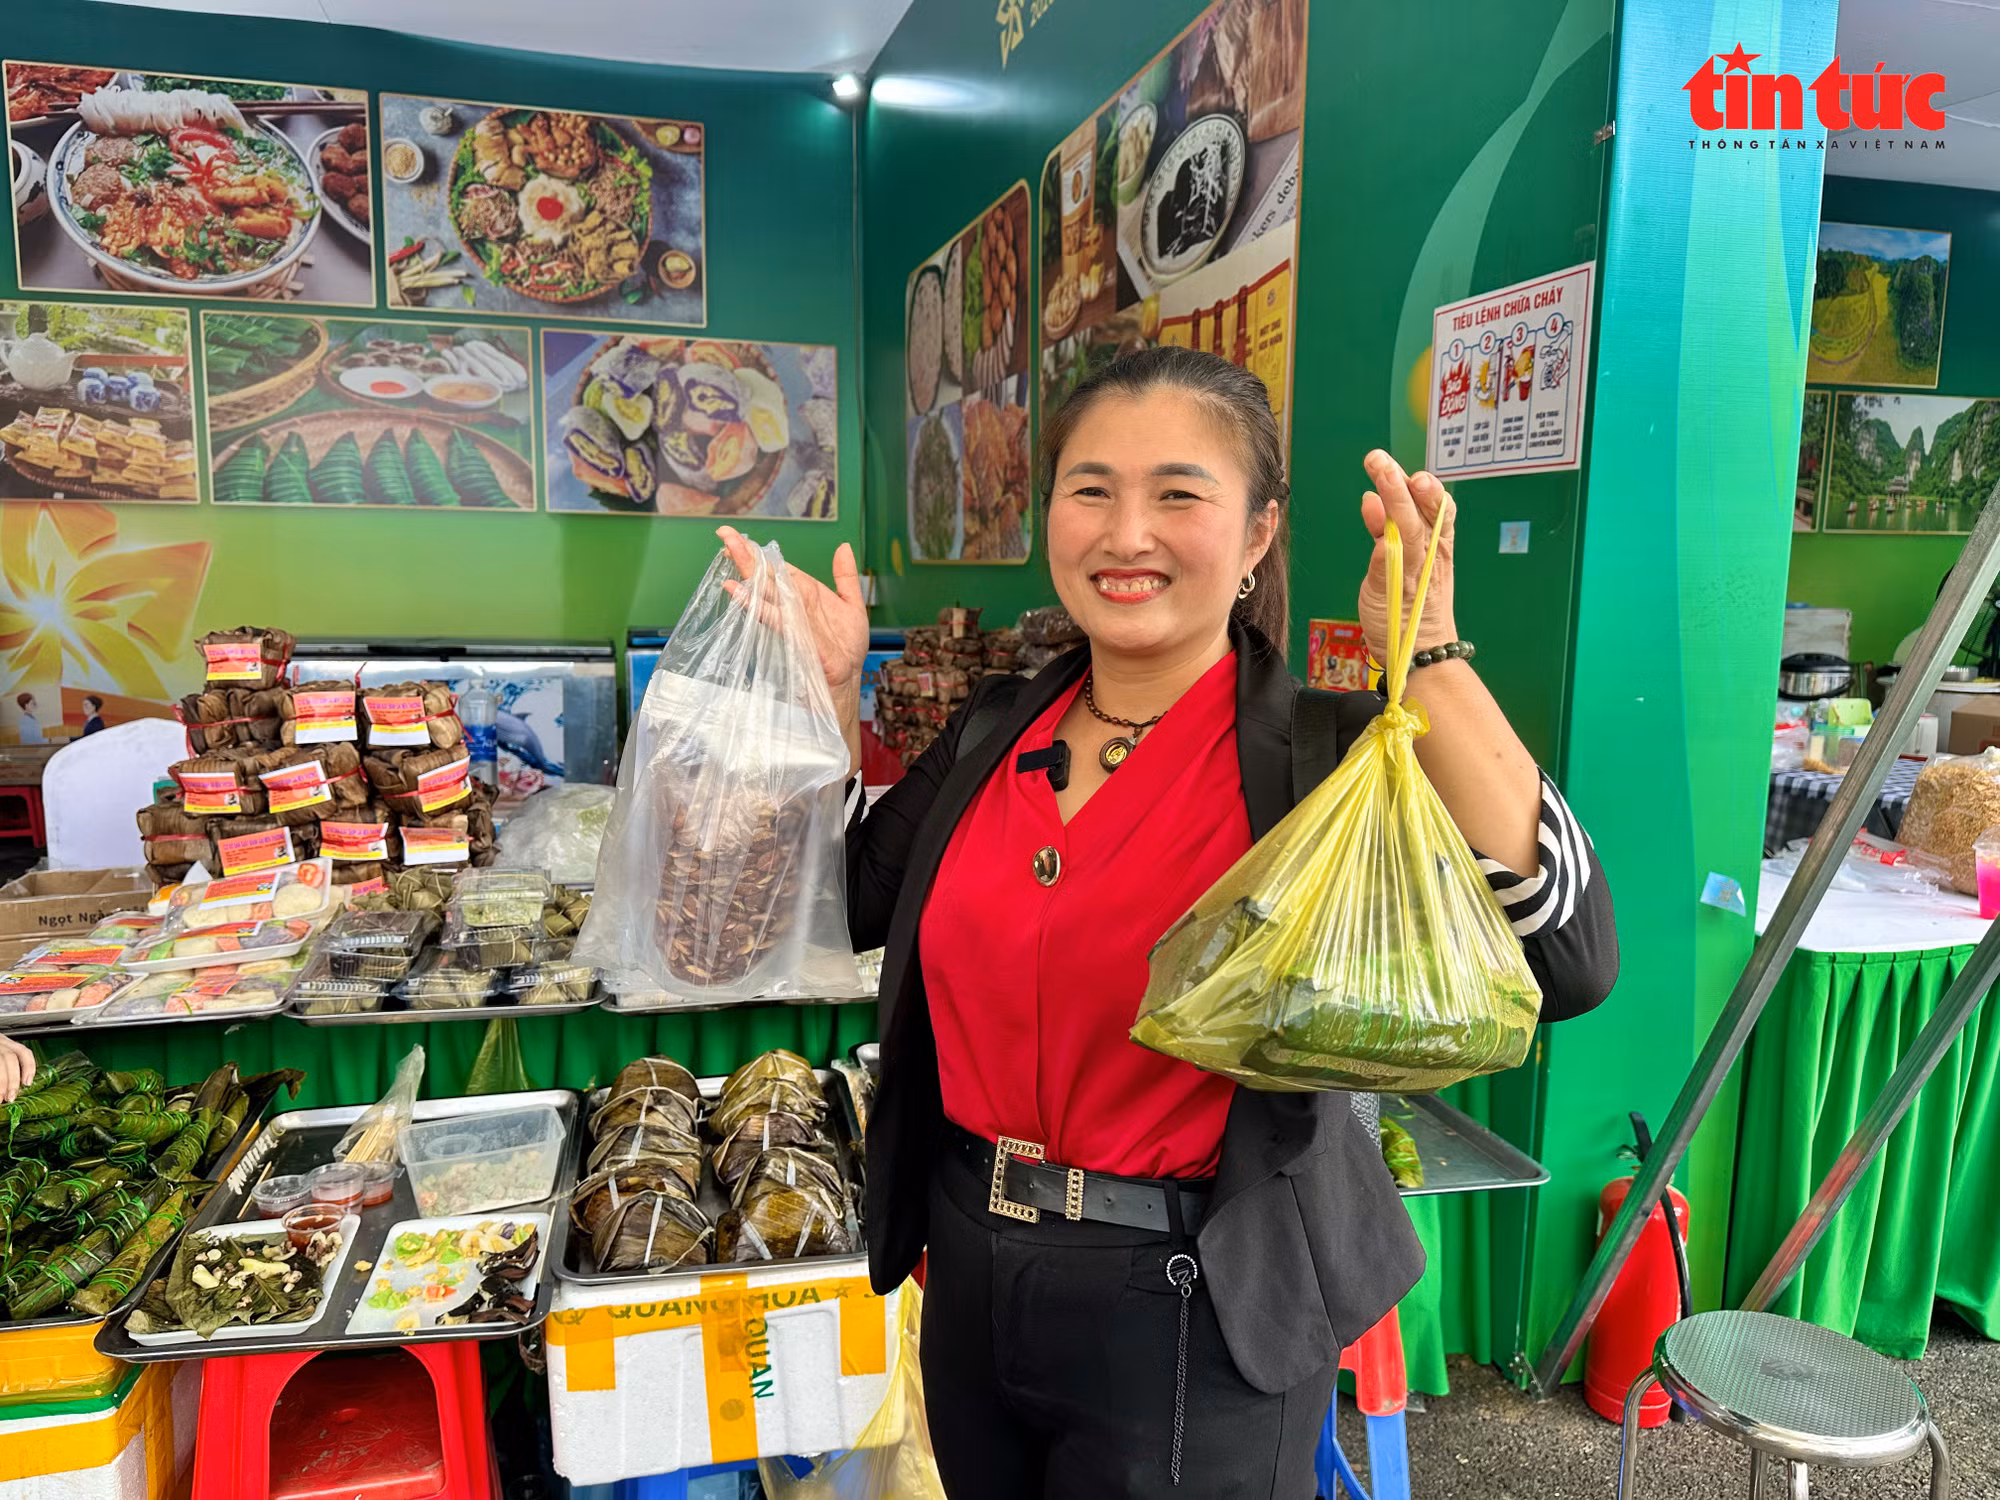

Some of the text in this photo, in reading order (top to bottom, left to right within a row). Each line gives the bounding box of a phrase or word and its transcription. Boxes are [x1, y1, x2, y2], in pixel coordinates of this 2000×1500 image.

[1475, 305, 1501, 327] LỆNH
[1503, 294, 1531, 317] CHỮA
[1534, 286, 1564, 309] CHÁY
[1550, 318, 1558, 333] 4
[1516, 326, 1524, 342] 3
[1484, 335, 1492, 350] 2
[1453, 344, 1460, 357] 1
[38, 915, 73, 927] Ngọt
